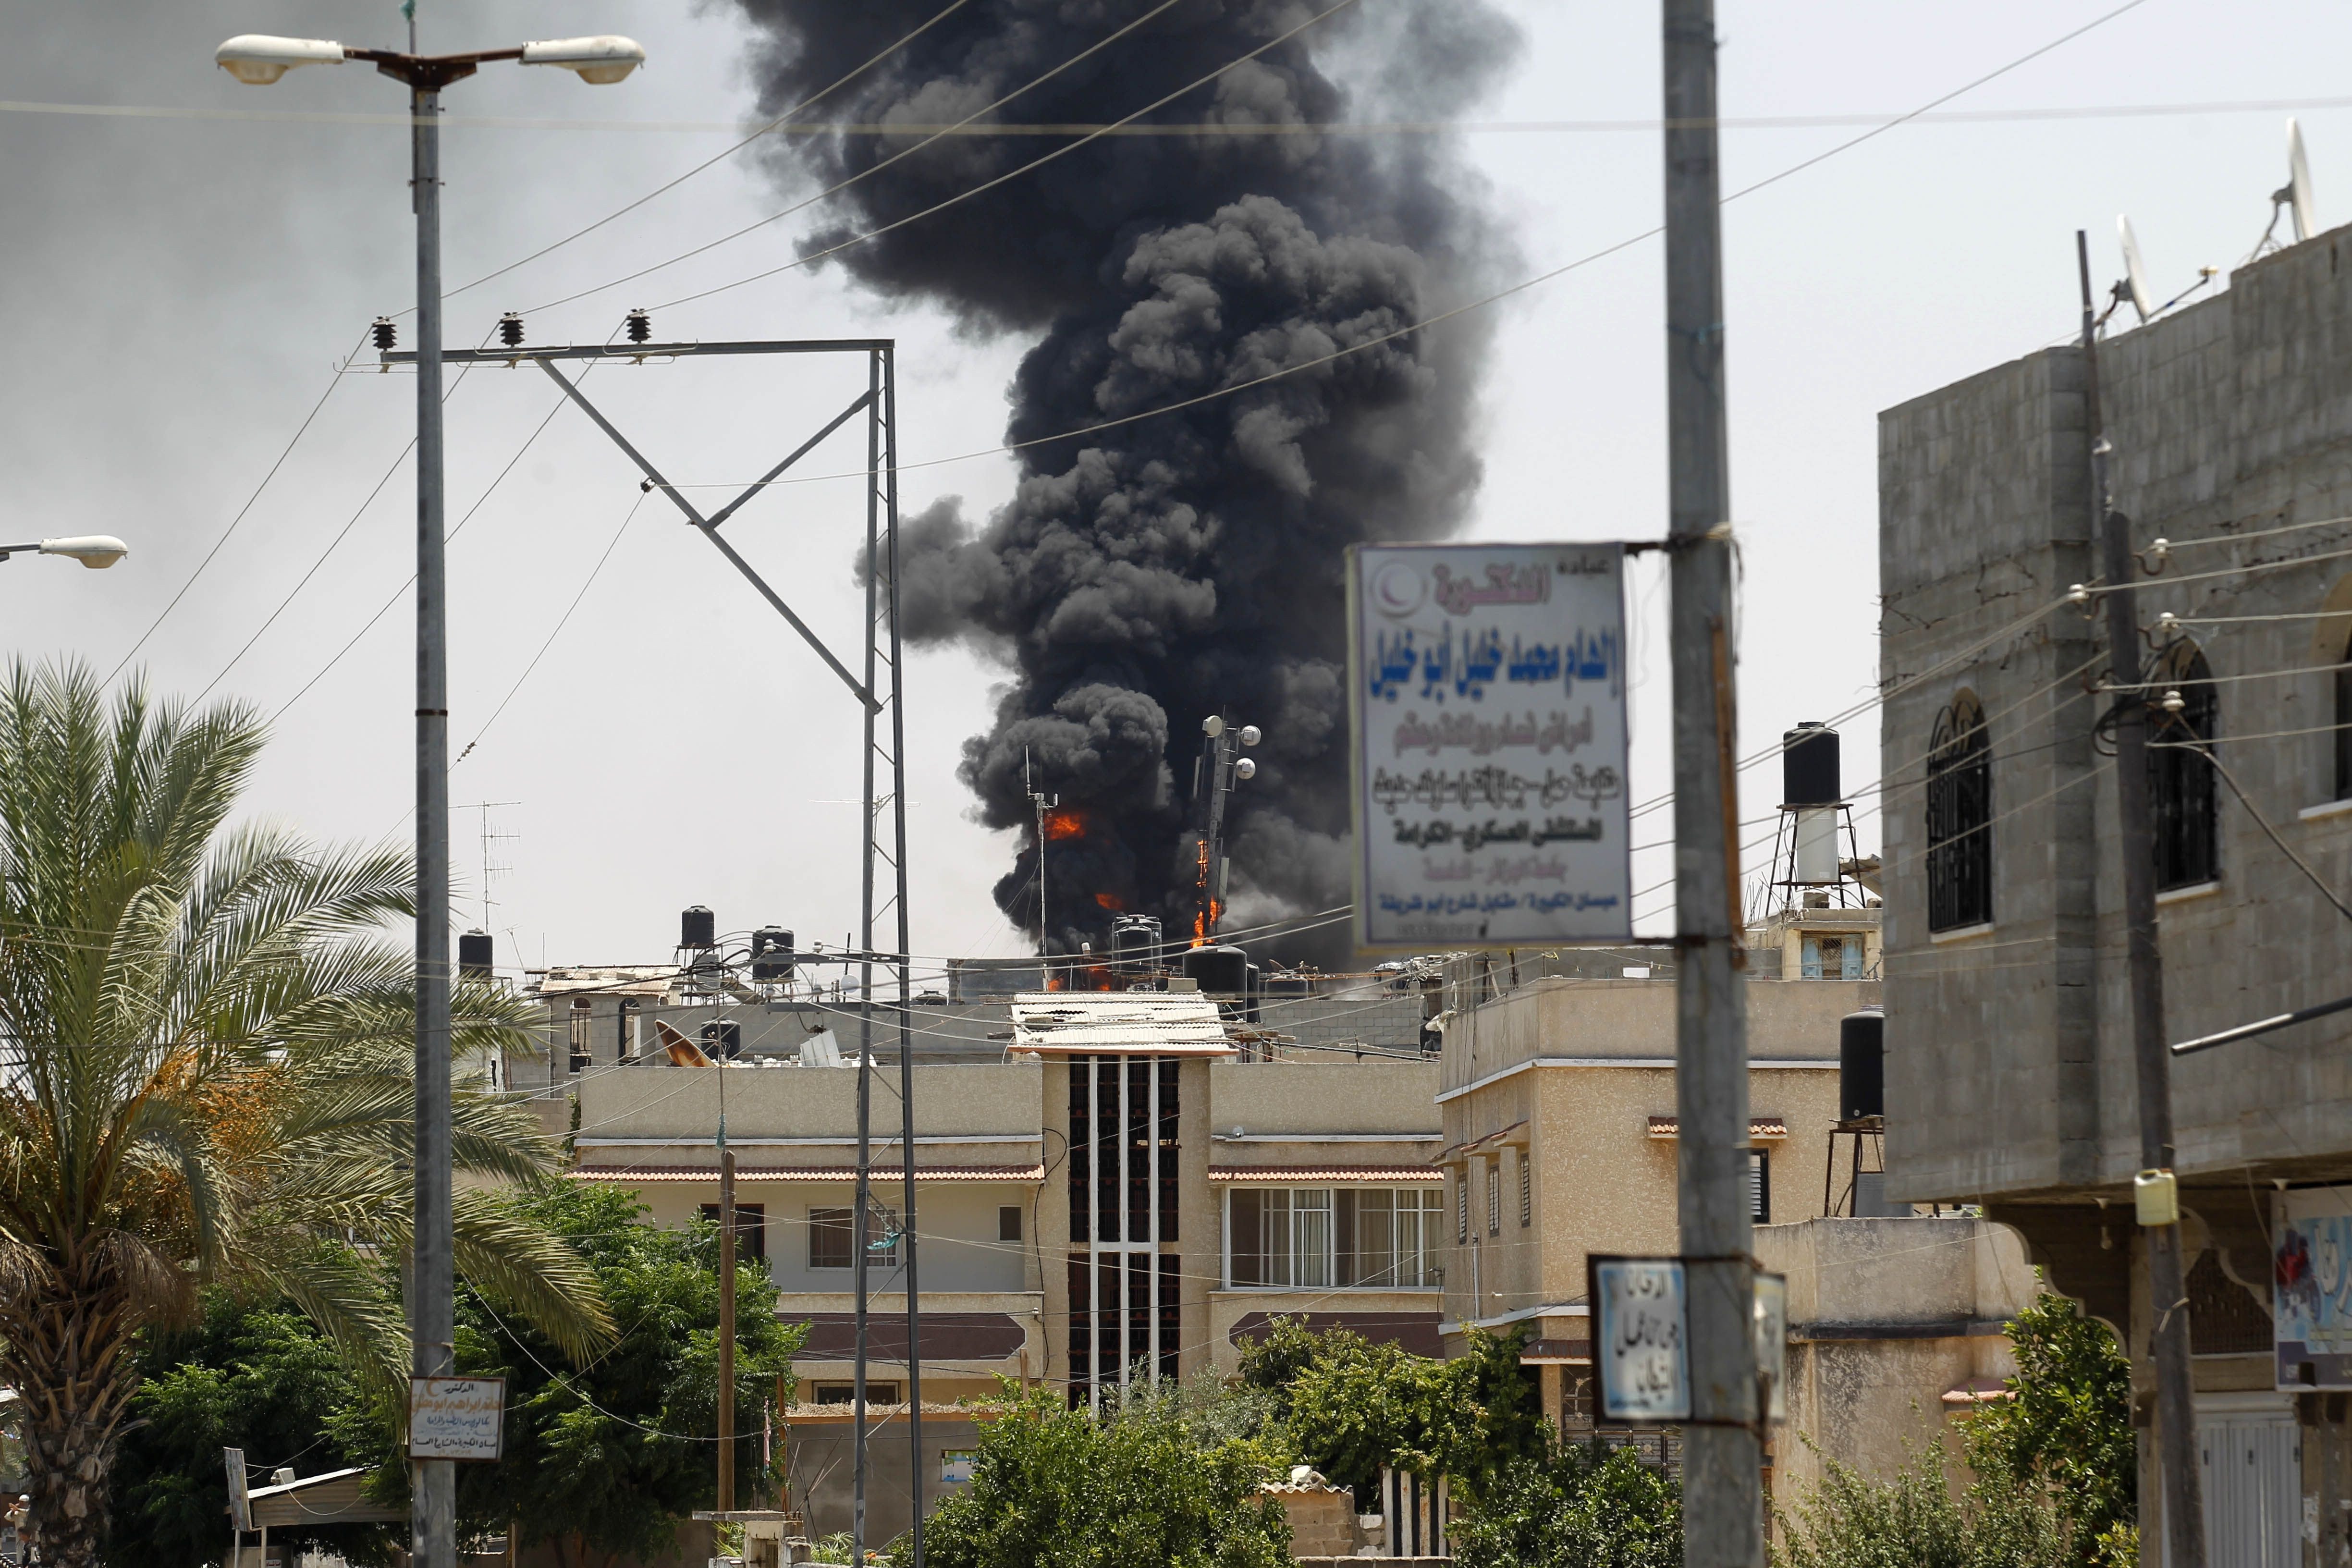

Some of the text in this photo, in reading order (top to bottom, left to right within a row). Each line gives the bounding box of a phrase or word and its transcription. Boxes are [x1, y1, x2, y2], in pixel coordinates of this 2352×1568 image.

[444, 1382, 474, 1394] الدكتور
[412, 1437, 433, 1446] العام
[435, 1437, 454, 1449] الشارع
